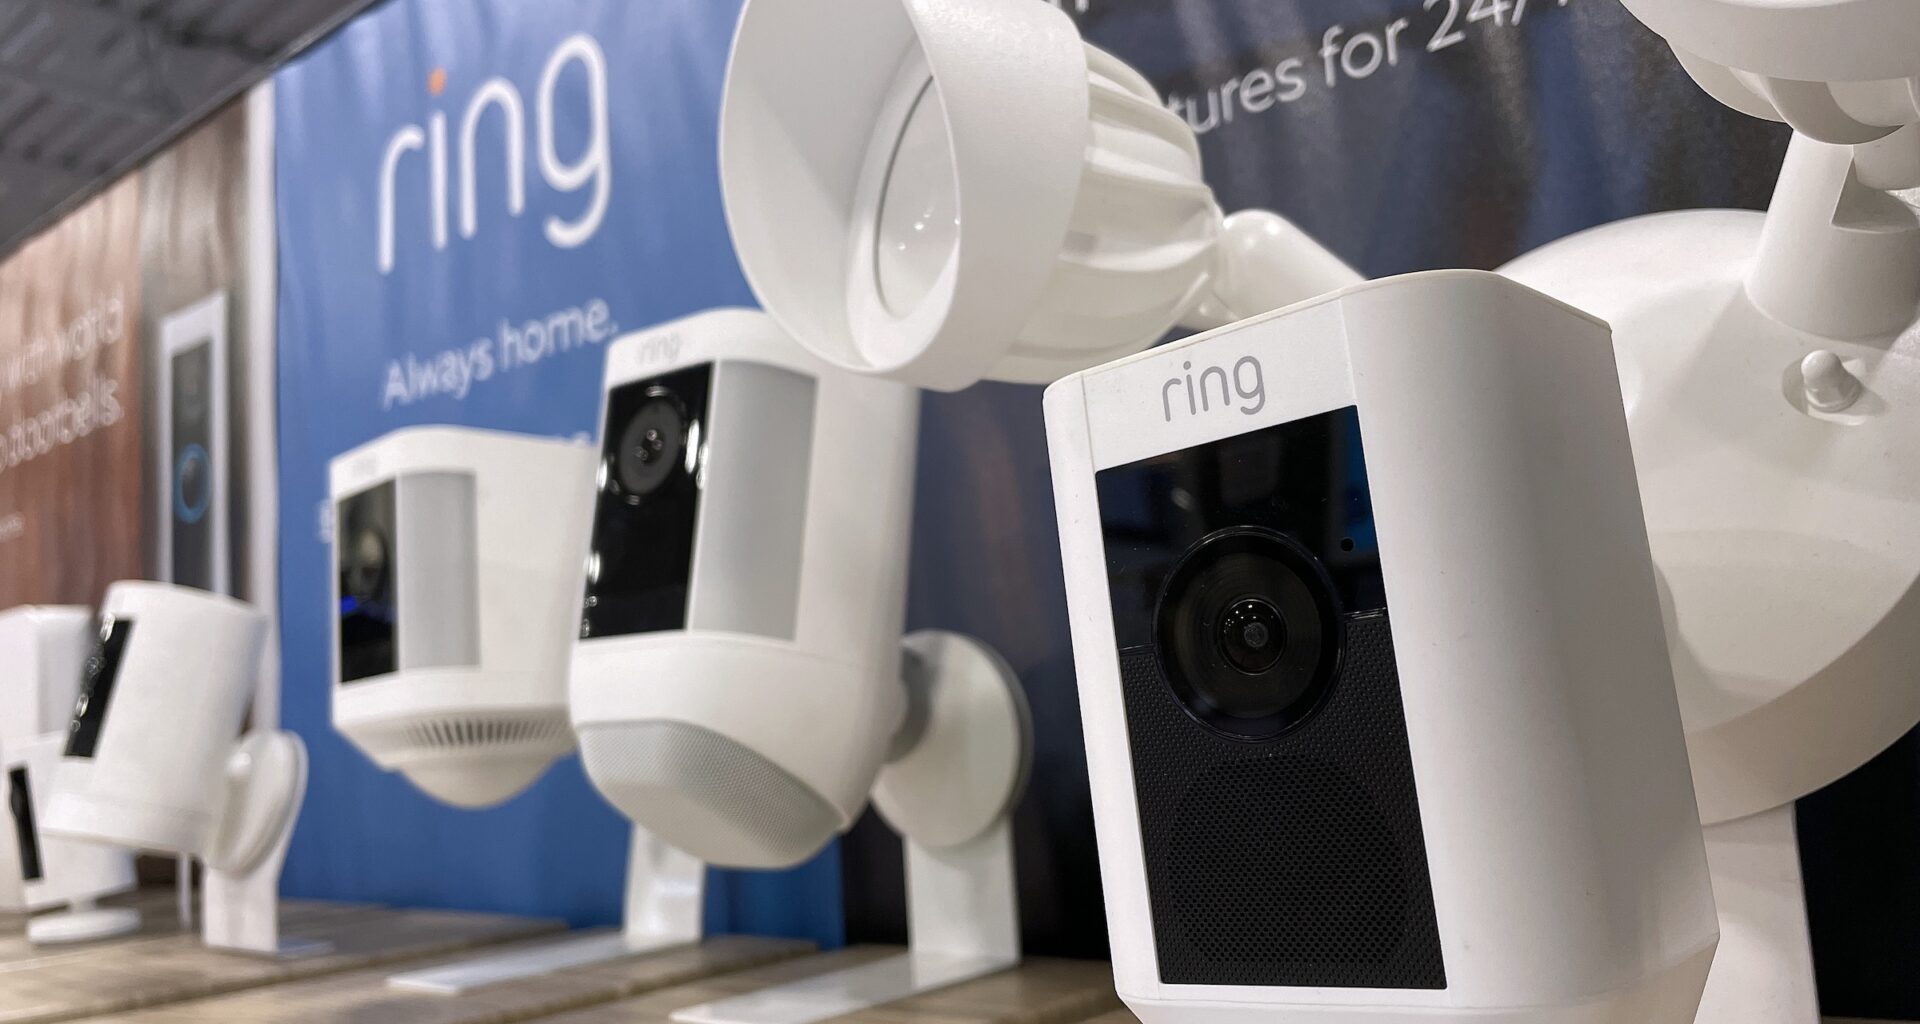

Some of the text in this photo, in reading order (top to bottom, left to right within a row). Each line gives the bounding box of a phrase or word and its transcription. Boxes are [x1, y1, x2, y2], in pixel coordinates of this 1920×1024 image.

[1319, 17, 1408, 88] for
[377, 32, 611, 275] ring
[382, 299, 619, 411] Always home.
[1161, 355, 1266, 422] ring
